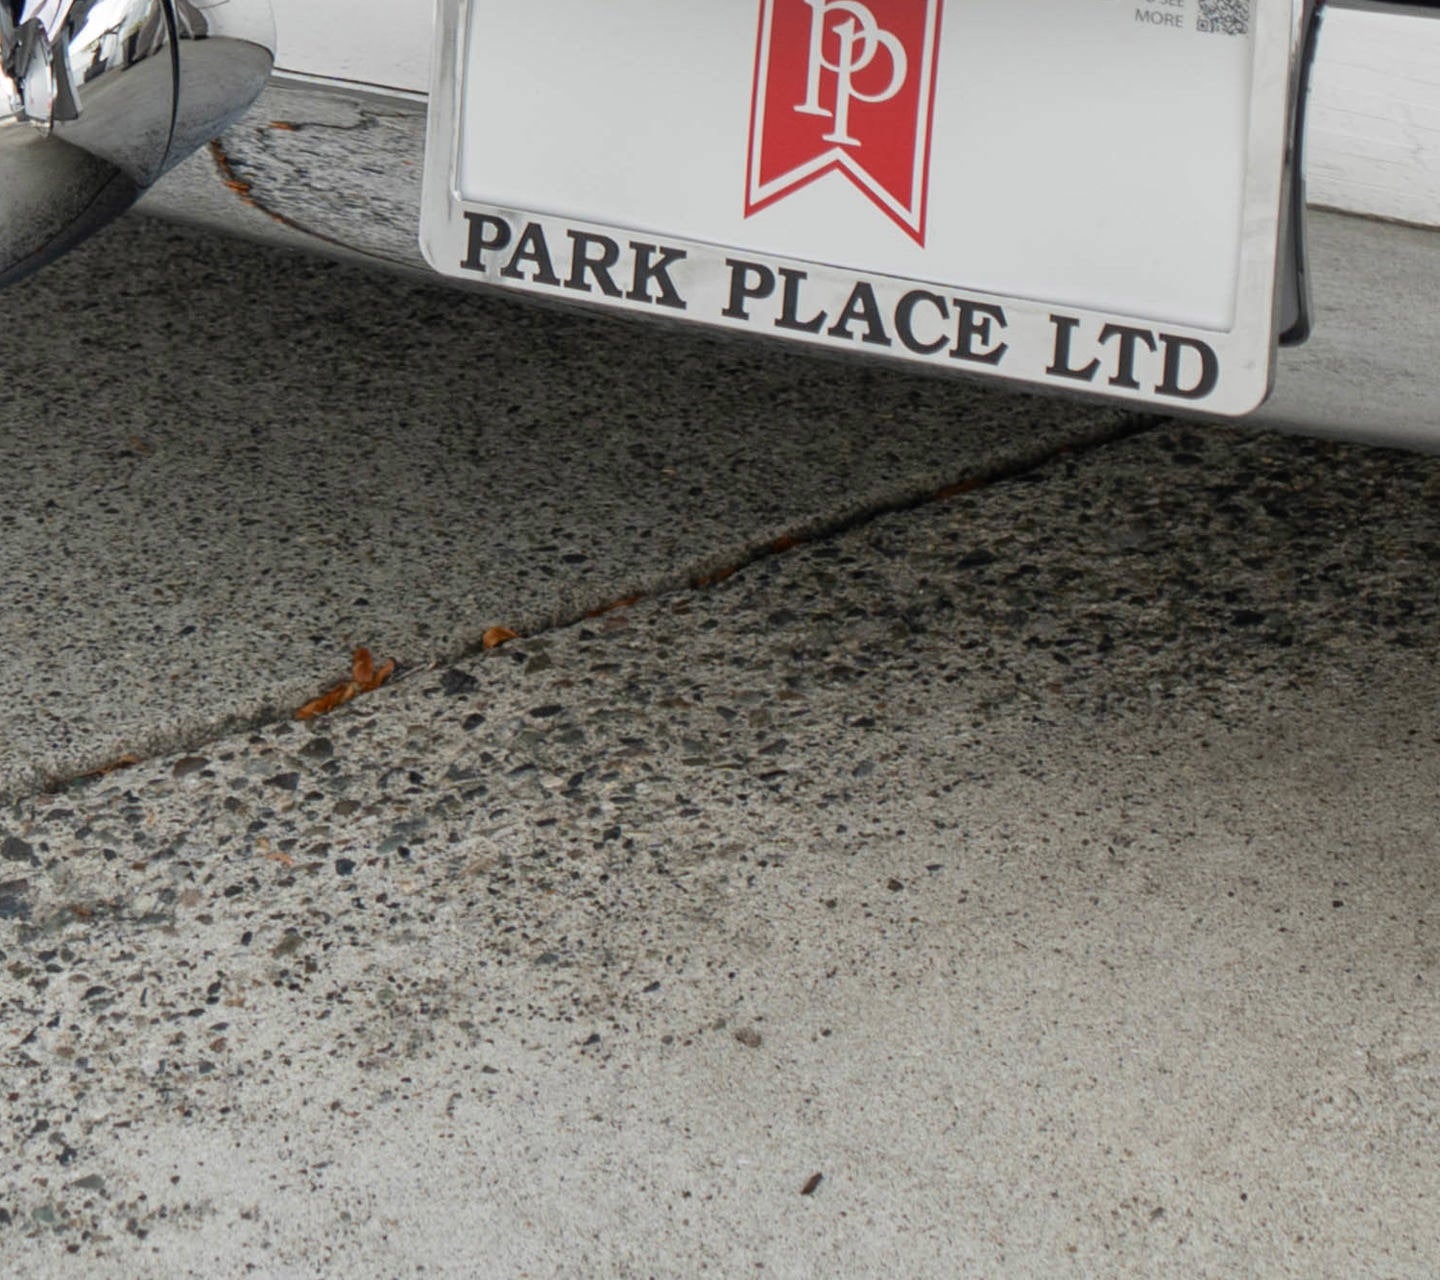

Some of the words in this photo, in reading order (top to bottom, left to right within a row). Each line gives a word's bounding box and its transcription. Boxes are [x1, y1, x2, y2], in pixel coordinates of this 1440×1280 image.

[1135, 8, 1184, 28] MORE
[460, 211, 687, 310] PARK
[721, 258, 1009, 366] PLACE
[1046, 313, 1220, 400] LTD
